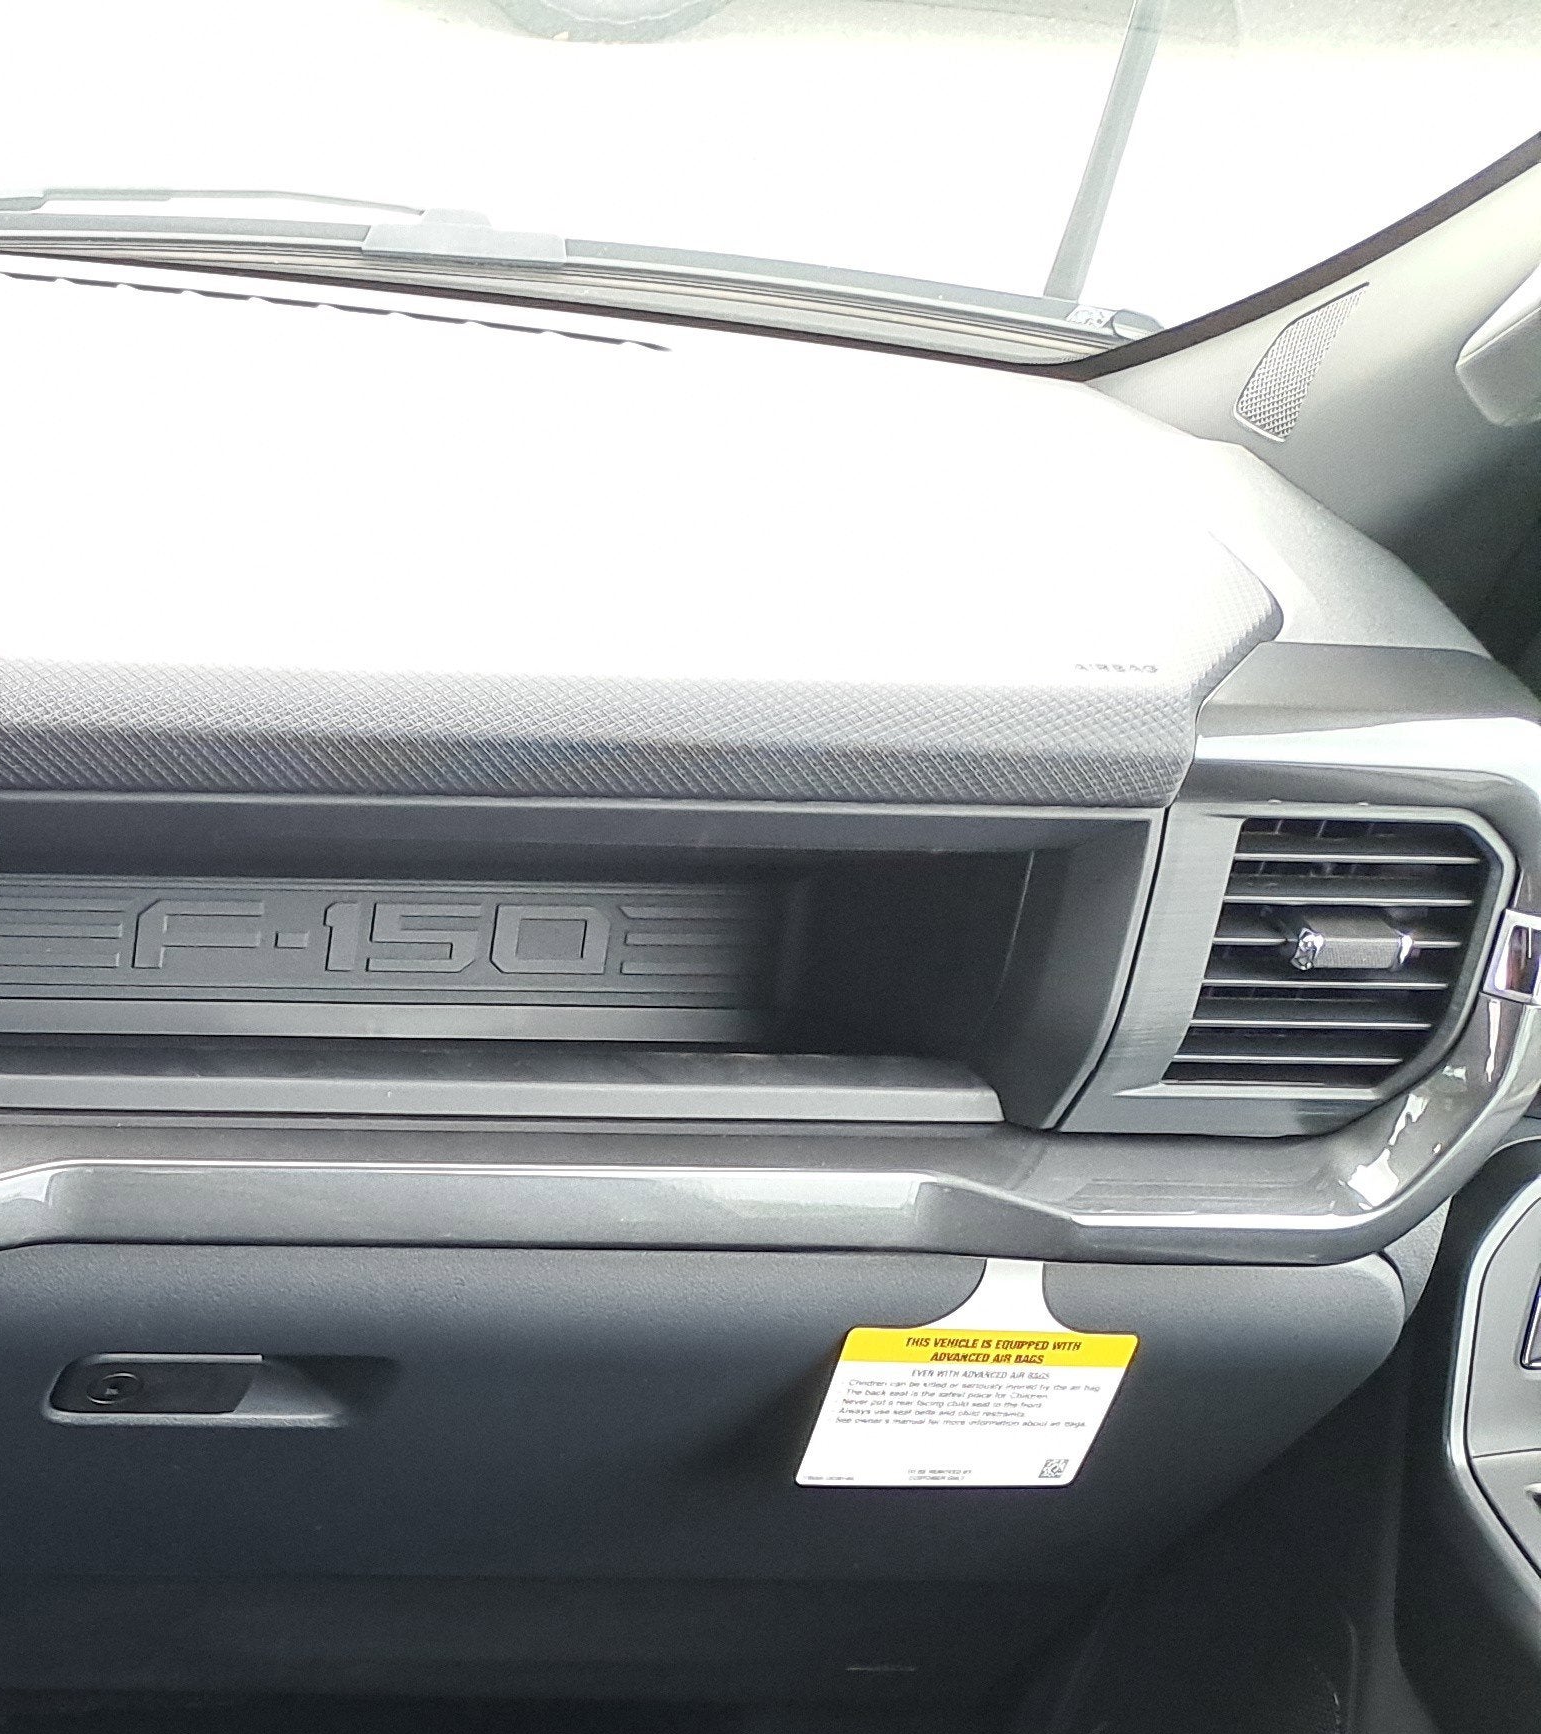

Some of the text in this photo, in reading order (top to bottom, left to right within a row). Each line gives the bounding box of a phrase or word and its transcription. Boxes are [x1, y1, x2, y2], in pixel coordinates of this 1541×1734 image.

[130, 898, 612, 975] F-150
[906, 1337, 1083, 1351] THIS VEHICLE IS EQUIPPED WITH
[929, 1351, 1045, 1365] ADVANCED AIR BAGS
